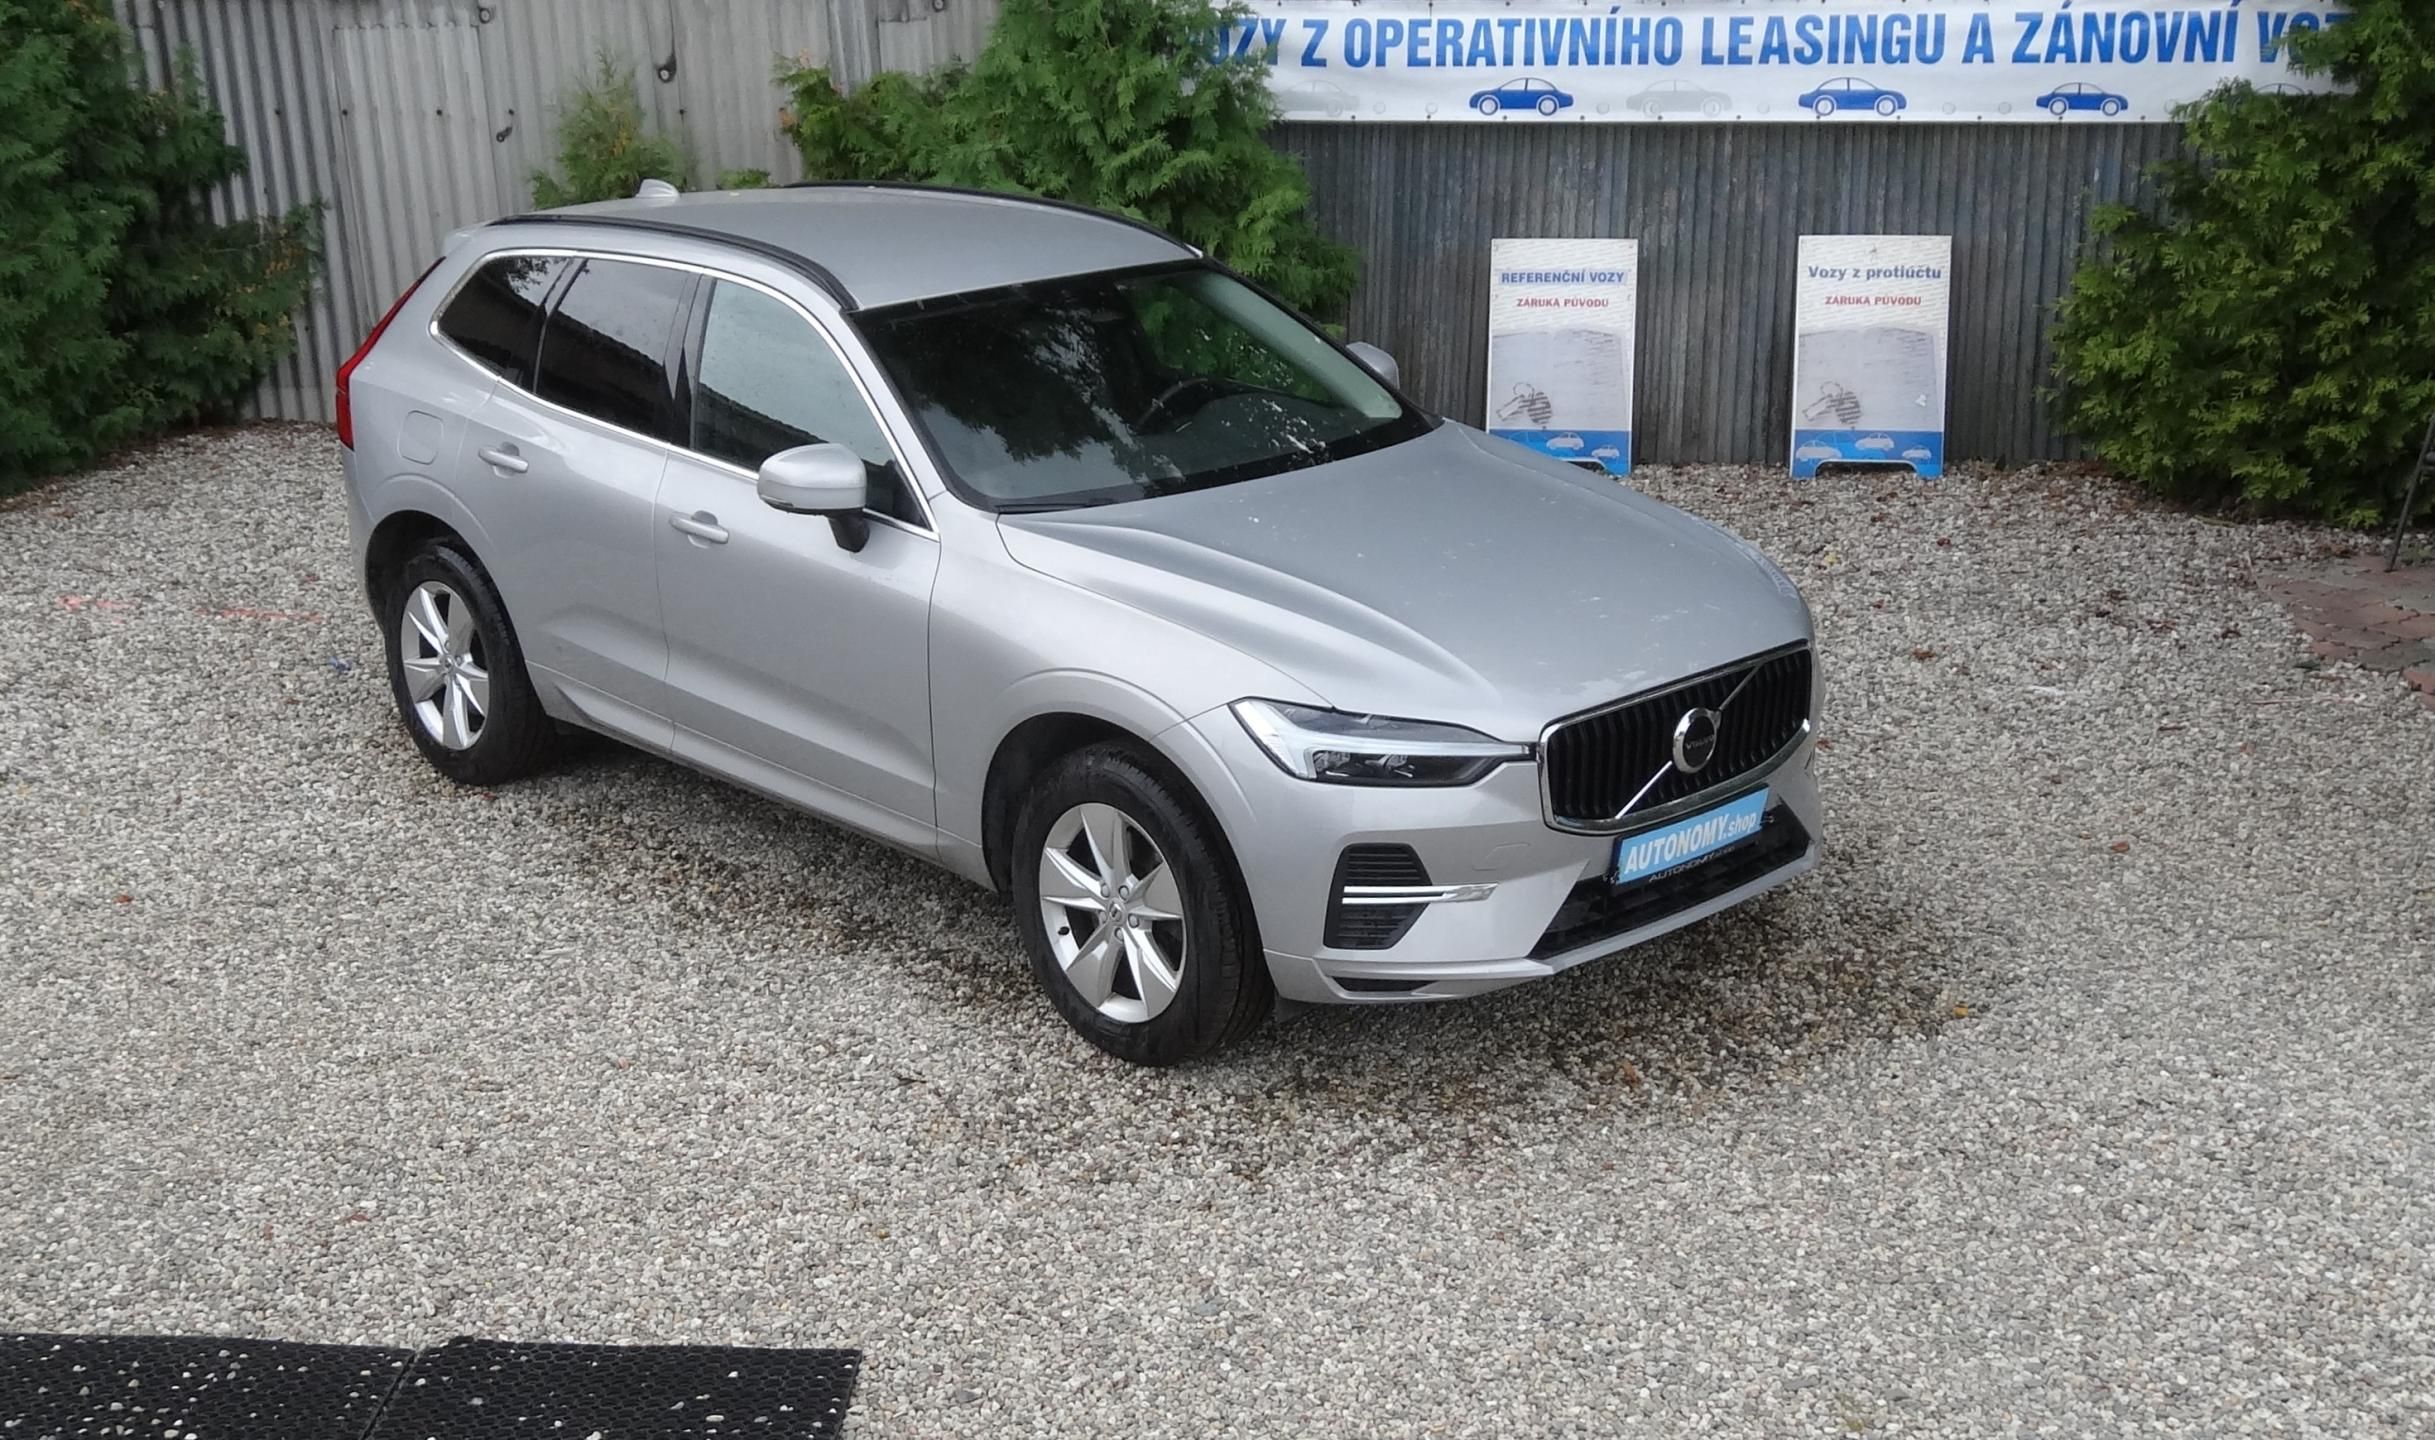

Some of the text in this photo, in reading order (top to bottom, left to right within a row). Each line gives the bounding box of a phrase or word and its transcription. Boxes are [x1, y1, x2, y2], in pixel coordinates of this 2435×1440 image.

[1195, 1, 2357, 68] OZY Z OPERATIVNÍHO LEASINGU A ZÁNOVNÍ VO
[1501, 269, 1624, 283] REFERENČNÍ VOZY
[1808, 264, 1942, 280] Vozy z protiúčtu
[1516, 296, 1560, 307] ZÁRUKA
[1824, 294, 1870, 305] ZÁRUKA
[1624, 811, 1758, 875] AUTONOMY.shop
